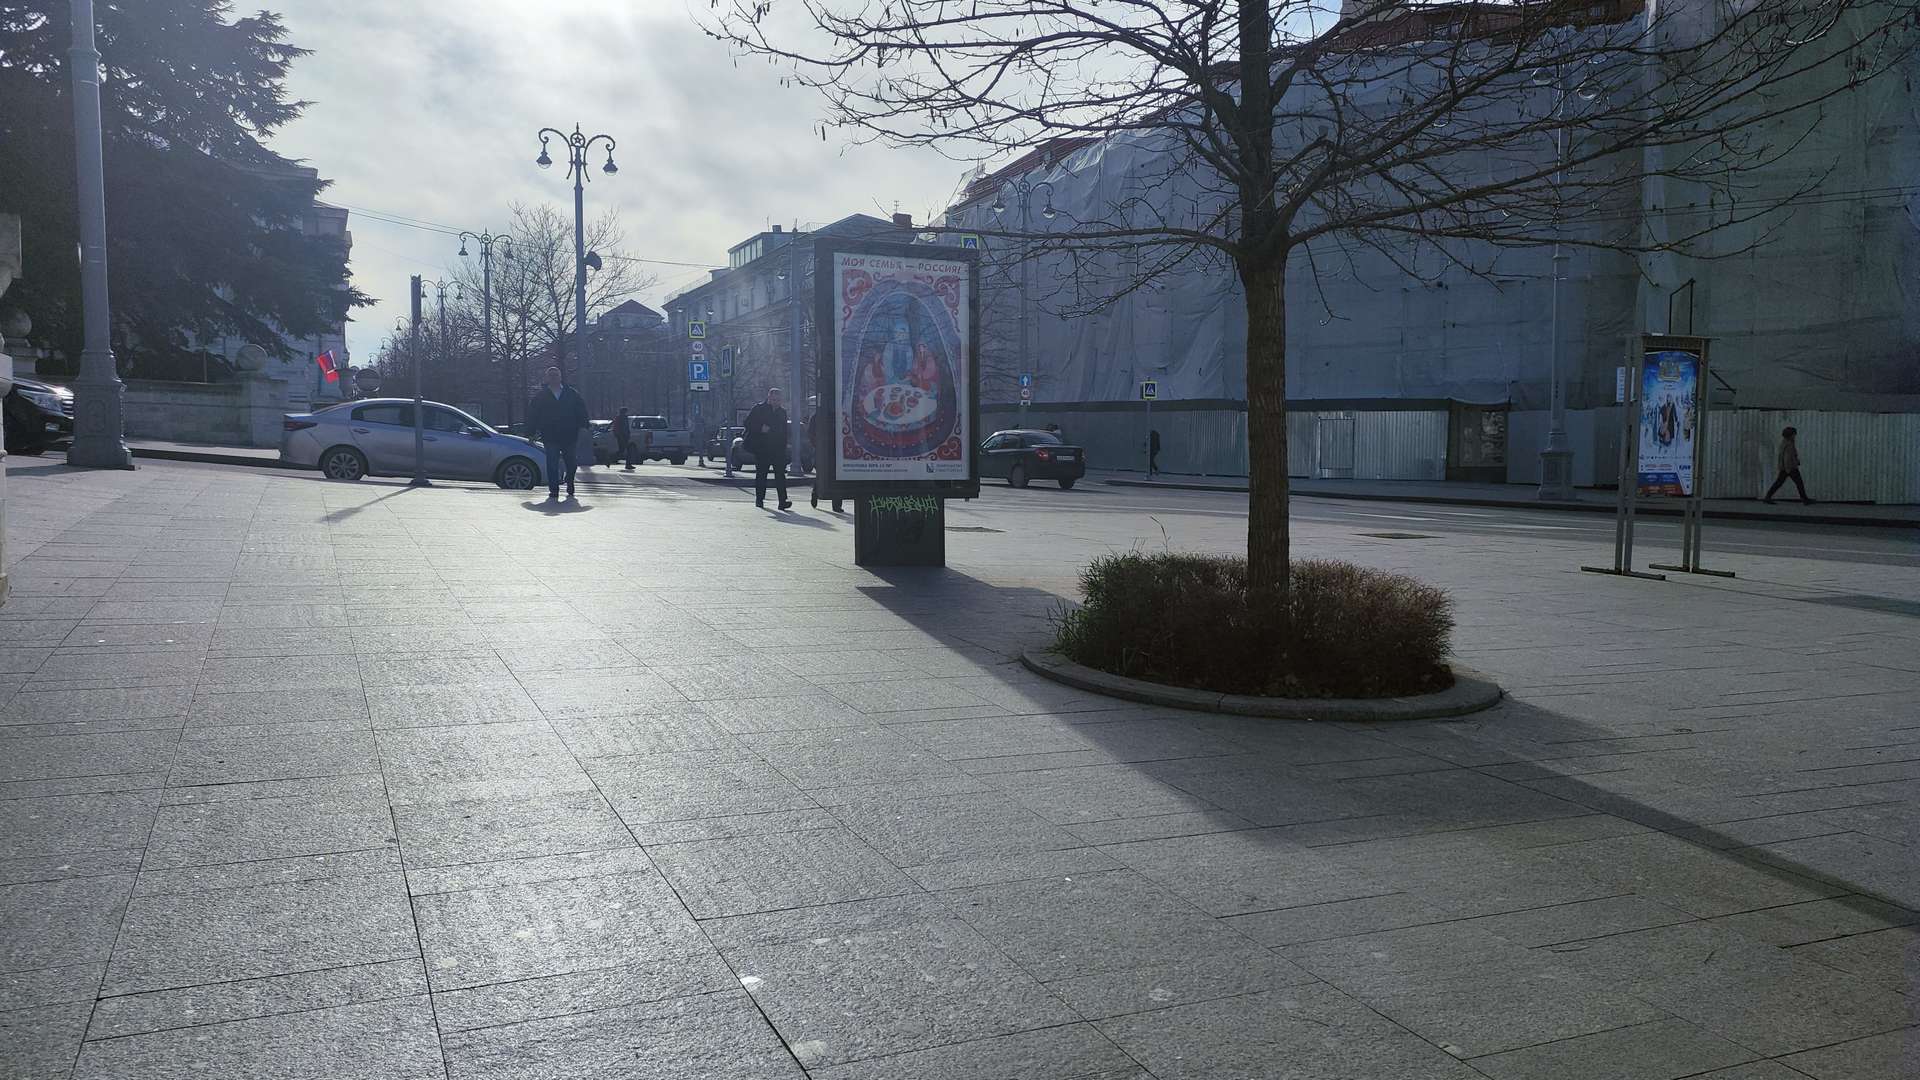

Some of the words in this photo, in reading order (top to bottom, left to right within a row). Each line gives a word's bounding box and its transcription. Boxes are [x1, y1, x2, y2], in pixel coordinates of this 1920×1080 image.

[841, 256, 865, 267] МОЯ
[869, 259, 902, 270] СЕМЬЯ
[918, 263, 962, 274] РОССИЯ!
